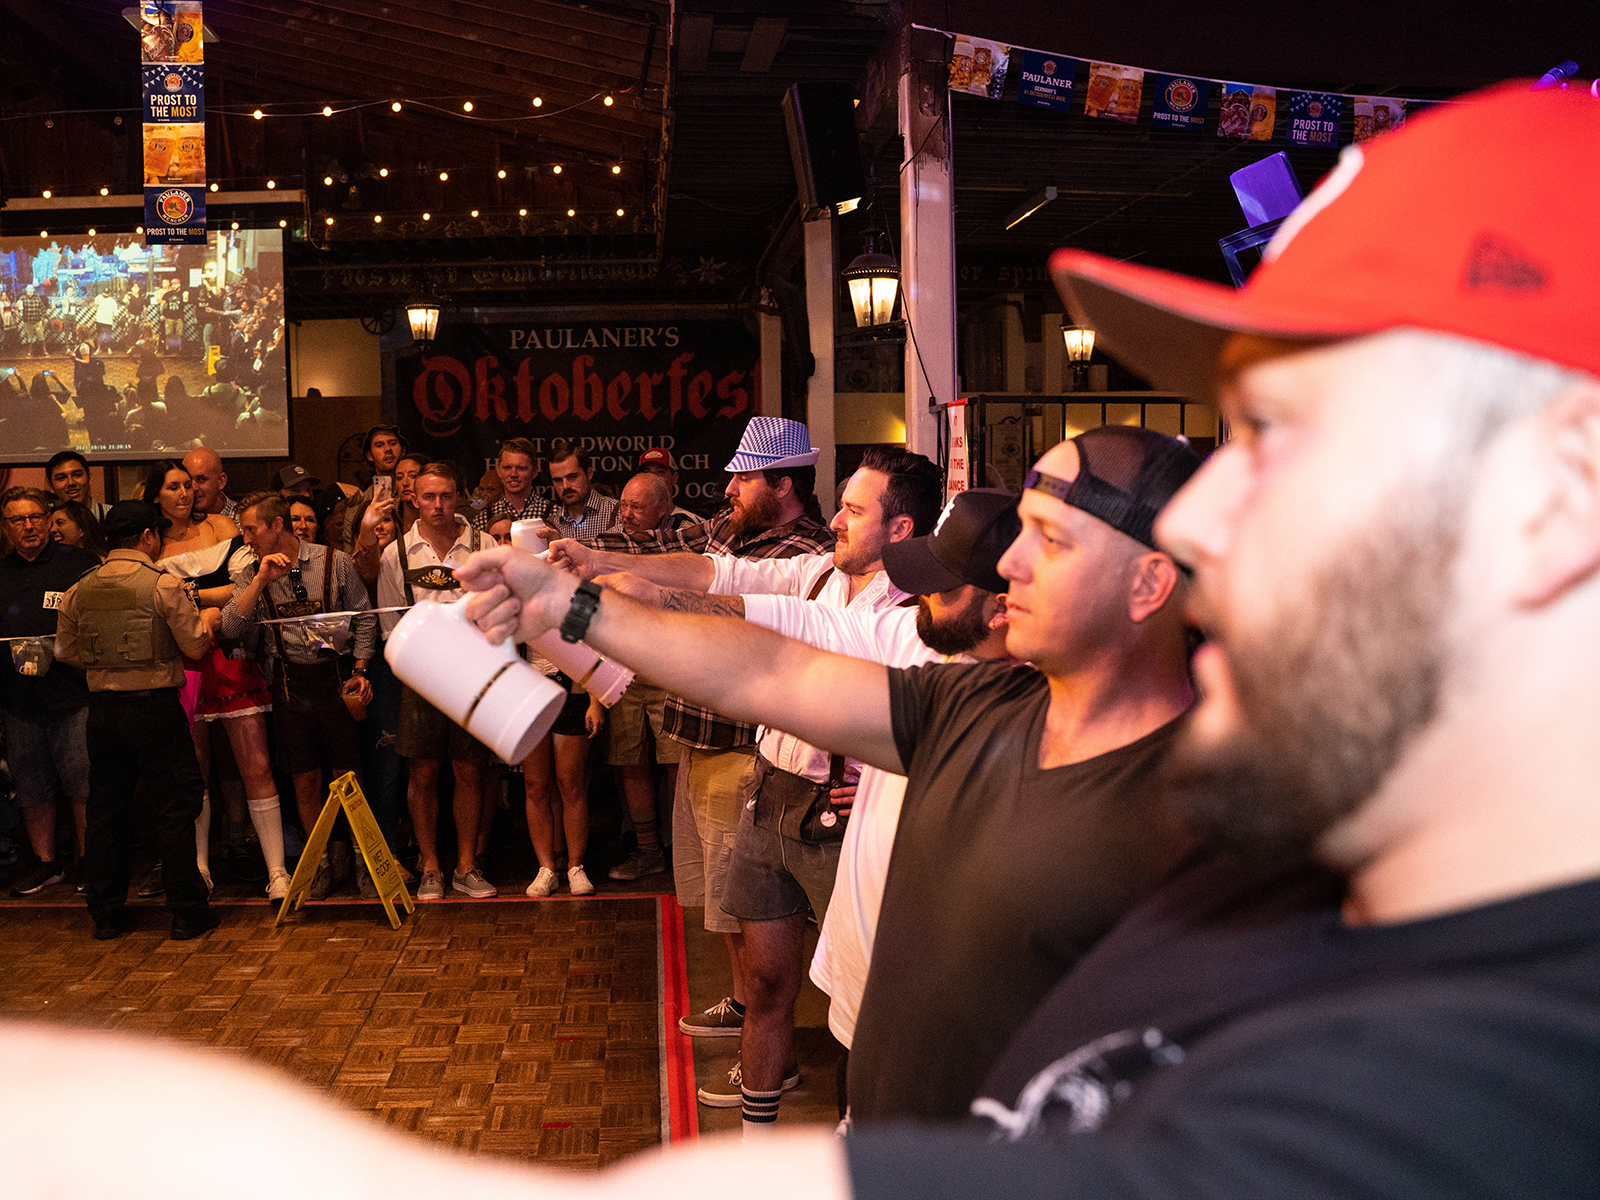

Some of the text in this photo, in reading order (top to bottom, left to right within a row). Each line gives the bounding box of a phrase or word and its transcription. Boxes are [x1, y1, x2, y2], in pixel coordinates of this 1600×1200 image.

[1021, 71, 1073, 90] PAULANER
[150, 94, 197, 106] PROST TO
[150, 106, 198, 117] THE MOST
[1153, 112, 1205, 125] PROST TO THE MOST
[1293, 118, 1334, 132] PROST TO
[1291, 129, 1333, 143] THE MOST
[159, 190, 191, 203] PAULANER
[146, 227, 205, 236] PROST TO THE MOST
[509, 326, 681, 350] PAULANER'S
[953, 458, 965, 470] THE
[372, 849, 384, 865] WET
[375, 859, 392, 878] FLOOR
